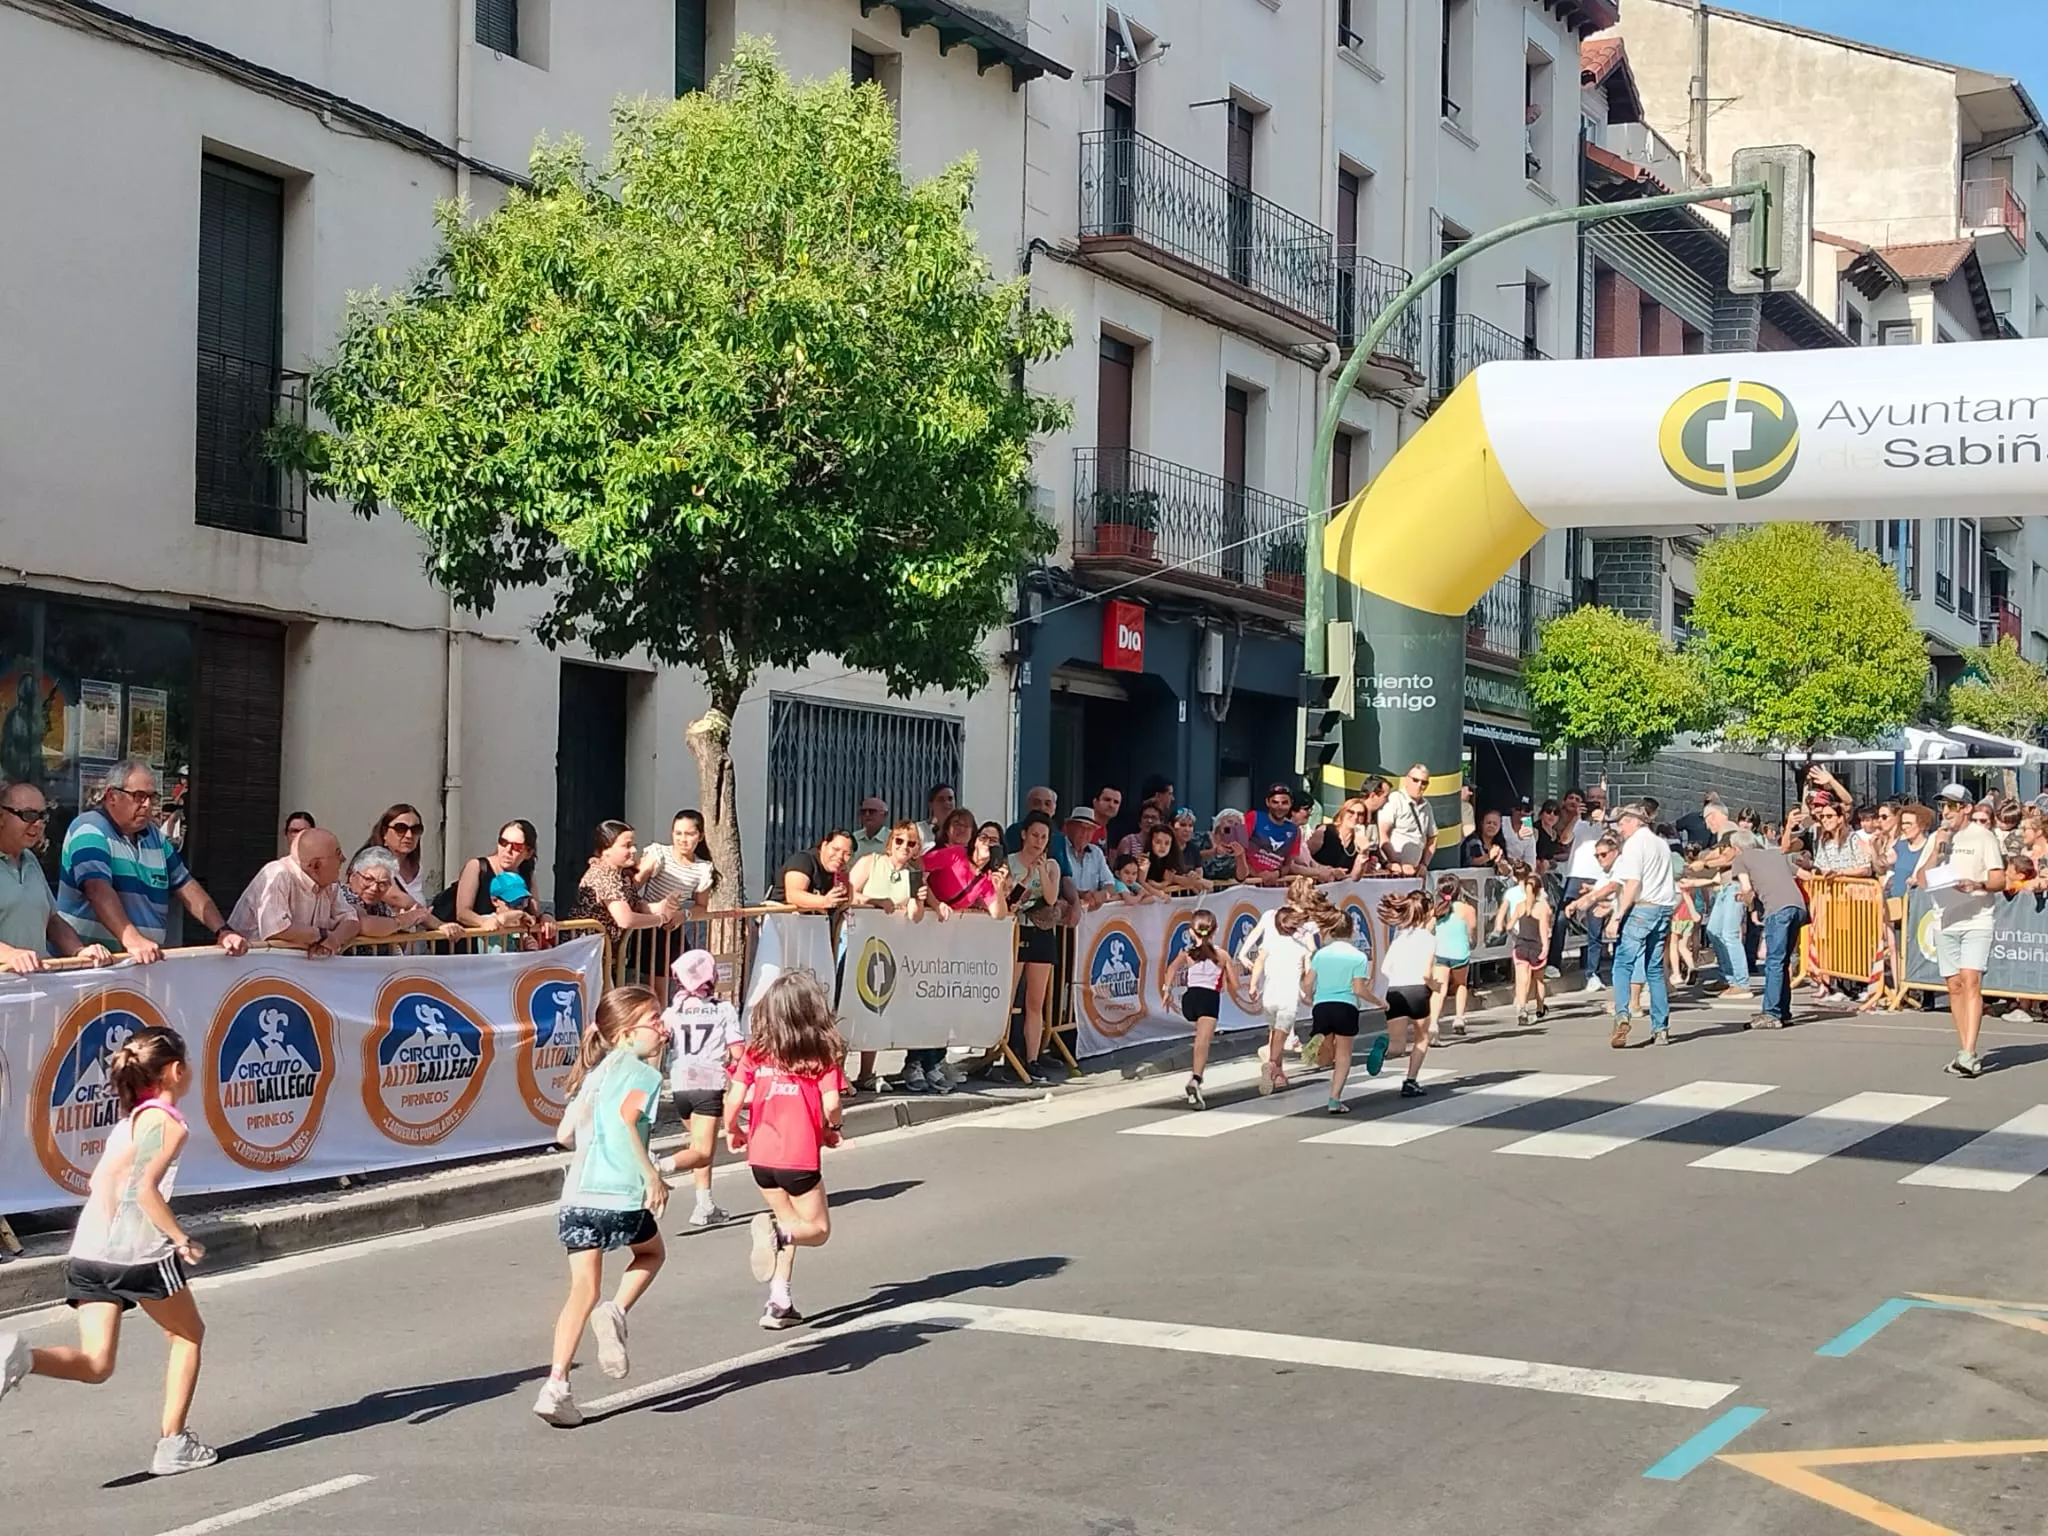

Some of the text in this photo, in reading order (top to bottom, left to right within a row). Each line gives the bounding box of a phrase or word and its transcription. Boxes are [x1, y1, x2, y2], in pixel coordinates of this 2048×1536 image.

[1883, 433, 2048, 468] Sabiñ
[1118, 624, 1142, 652] Dia
[1994, 929, 2048, 944] untam
[1993, 945, 2048, 962] Sabiñ
[901, 955, 998, 977] Ayuntamiento
[915, 980, 1000, 1003] Sabiñánigo
[681, 1023, 715, 1055] 17
[399, 1043, 461, 1063] CIRCUITO
[238, 1059, 302, 1079] CIRCUITO
[75, 1082, 120, 1102] CIRC
[401, 1090, 449, 1108] PIRINEOS
[247, 1111, 294, 1130] PIRINEOS
[385, 1109, 460, 1140] CARRERAS POPULARES
[80, 1140, 106, 1157] PIRI
[64, 1169, 92, 1192] CARRE
